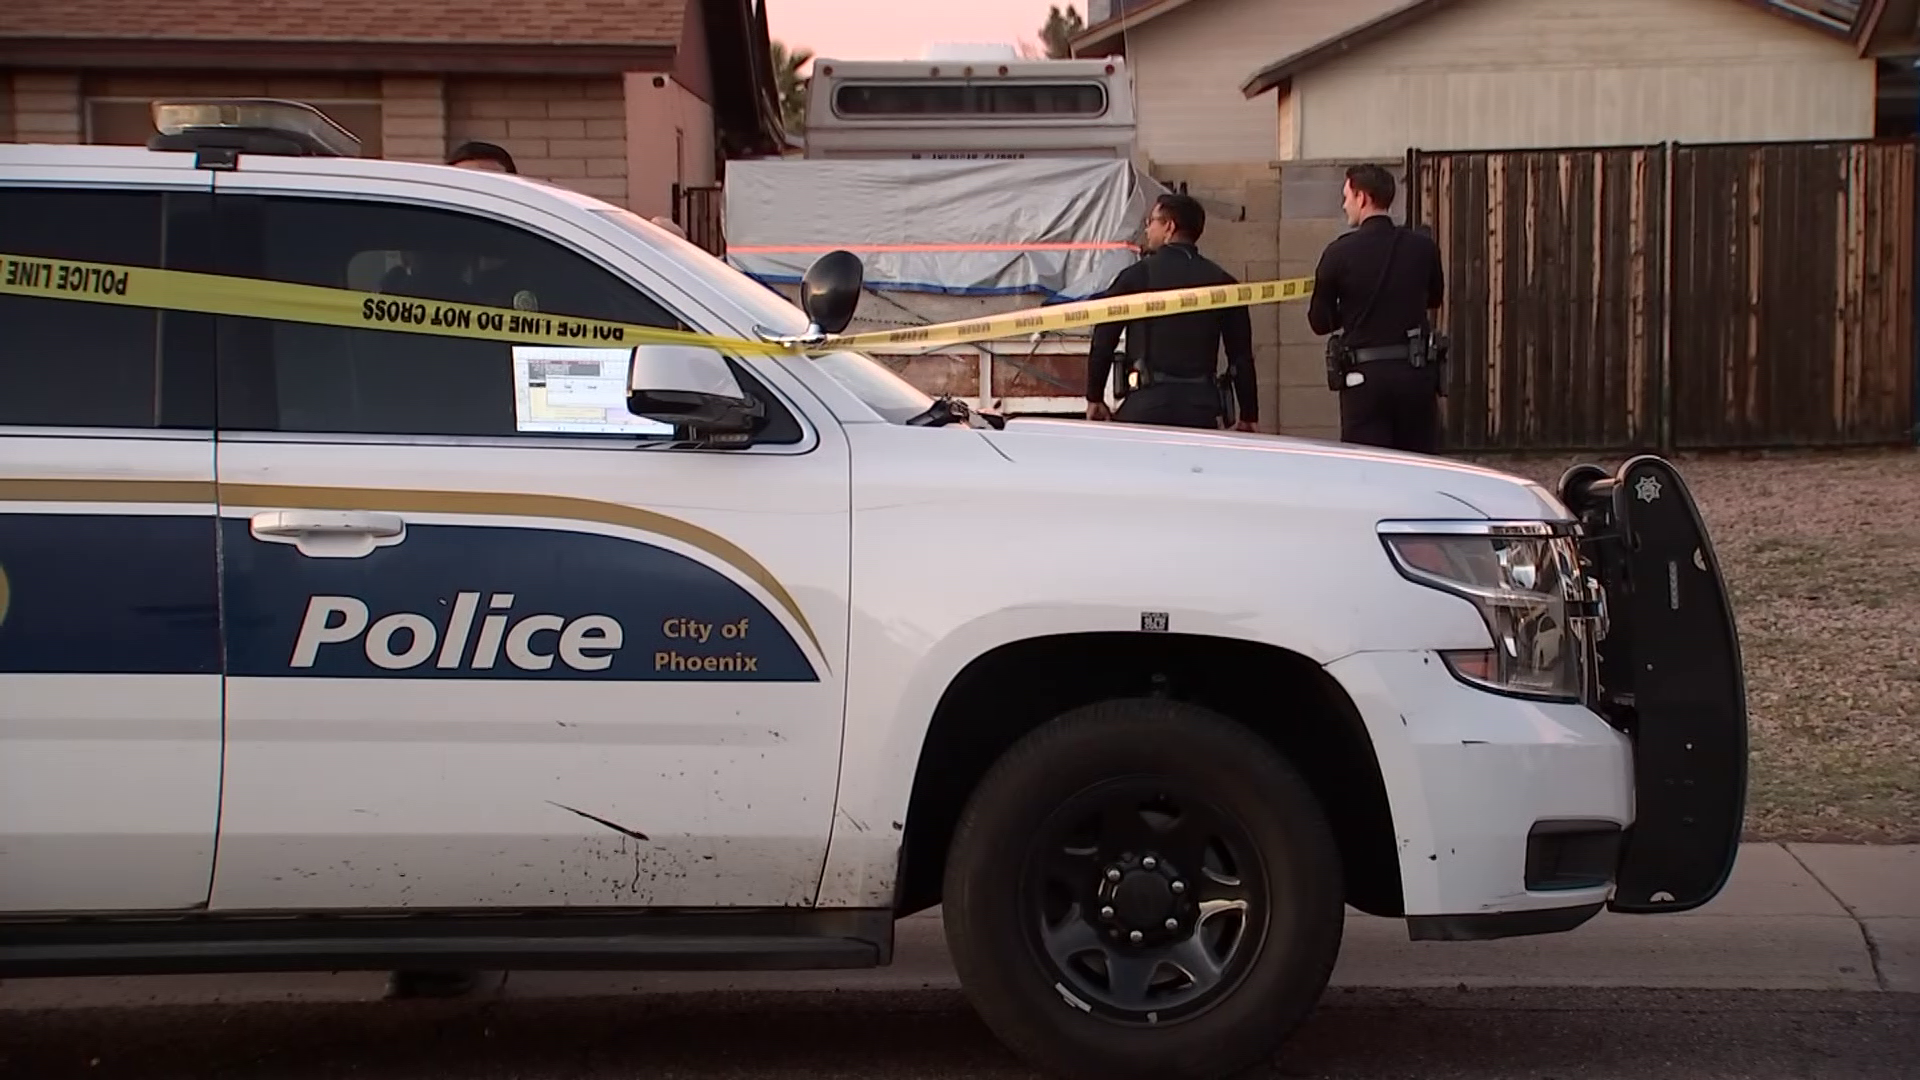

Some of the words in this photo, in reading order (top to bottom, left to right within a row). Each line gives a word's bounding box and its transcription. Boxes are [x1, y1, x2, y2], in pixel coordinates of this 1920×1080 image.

[6, 260, 52, 289] LINE
[56, 265, 129, 296] POLICE
[362, 297, 427, 326] CROSS
[430, 305, 472, 330] NOT
[477, 311, 504, 331] DO
[509, 315, 552, 336] LINE
[290, 591, 625, 673] Police
[662, 618, 714, 643] City
[720, 617, 750, 640] of
[653, 651, 759, 673] Phoenix
